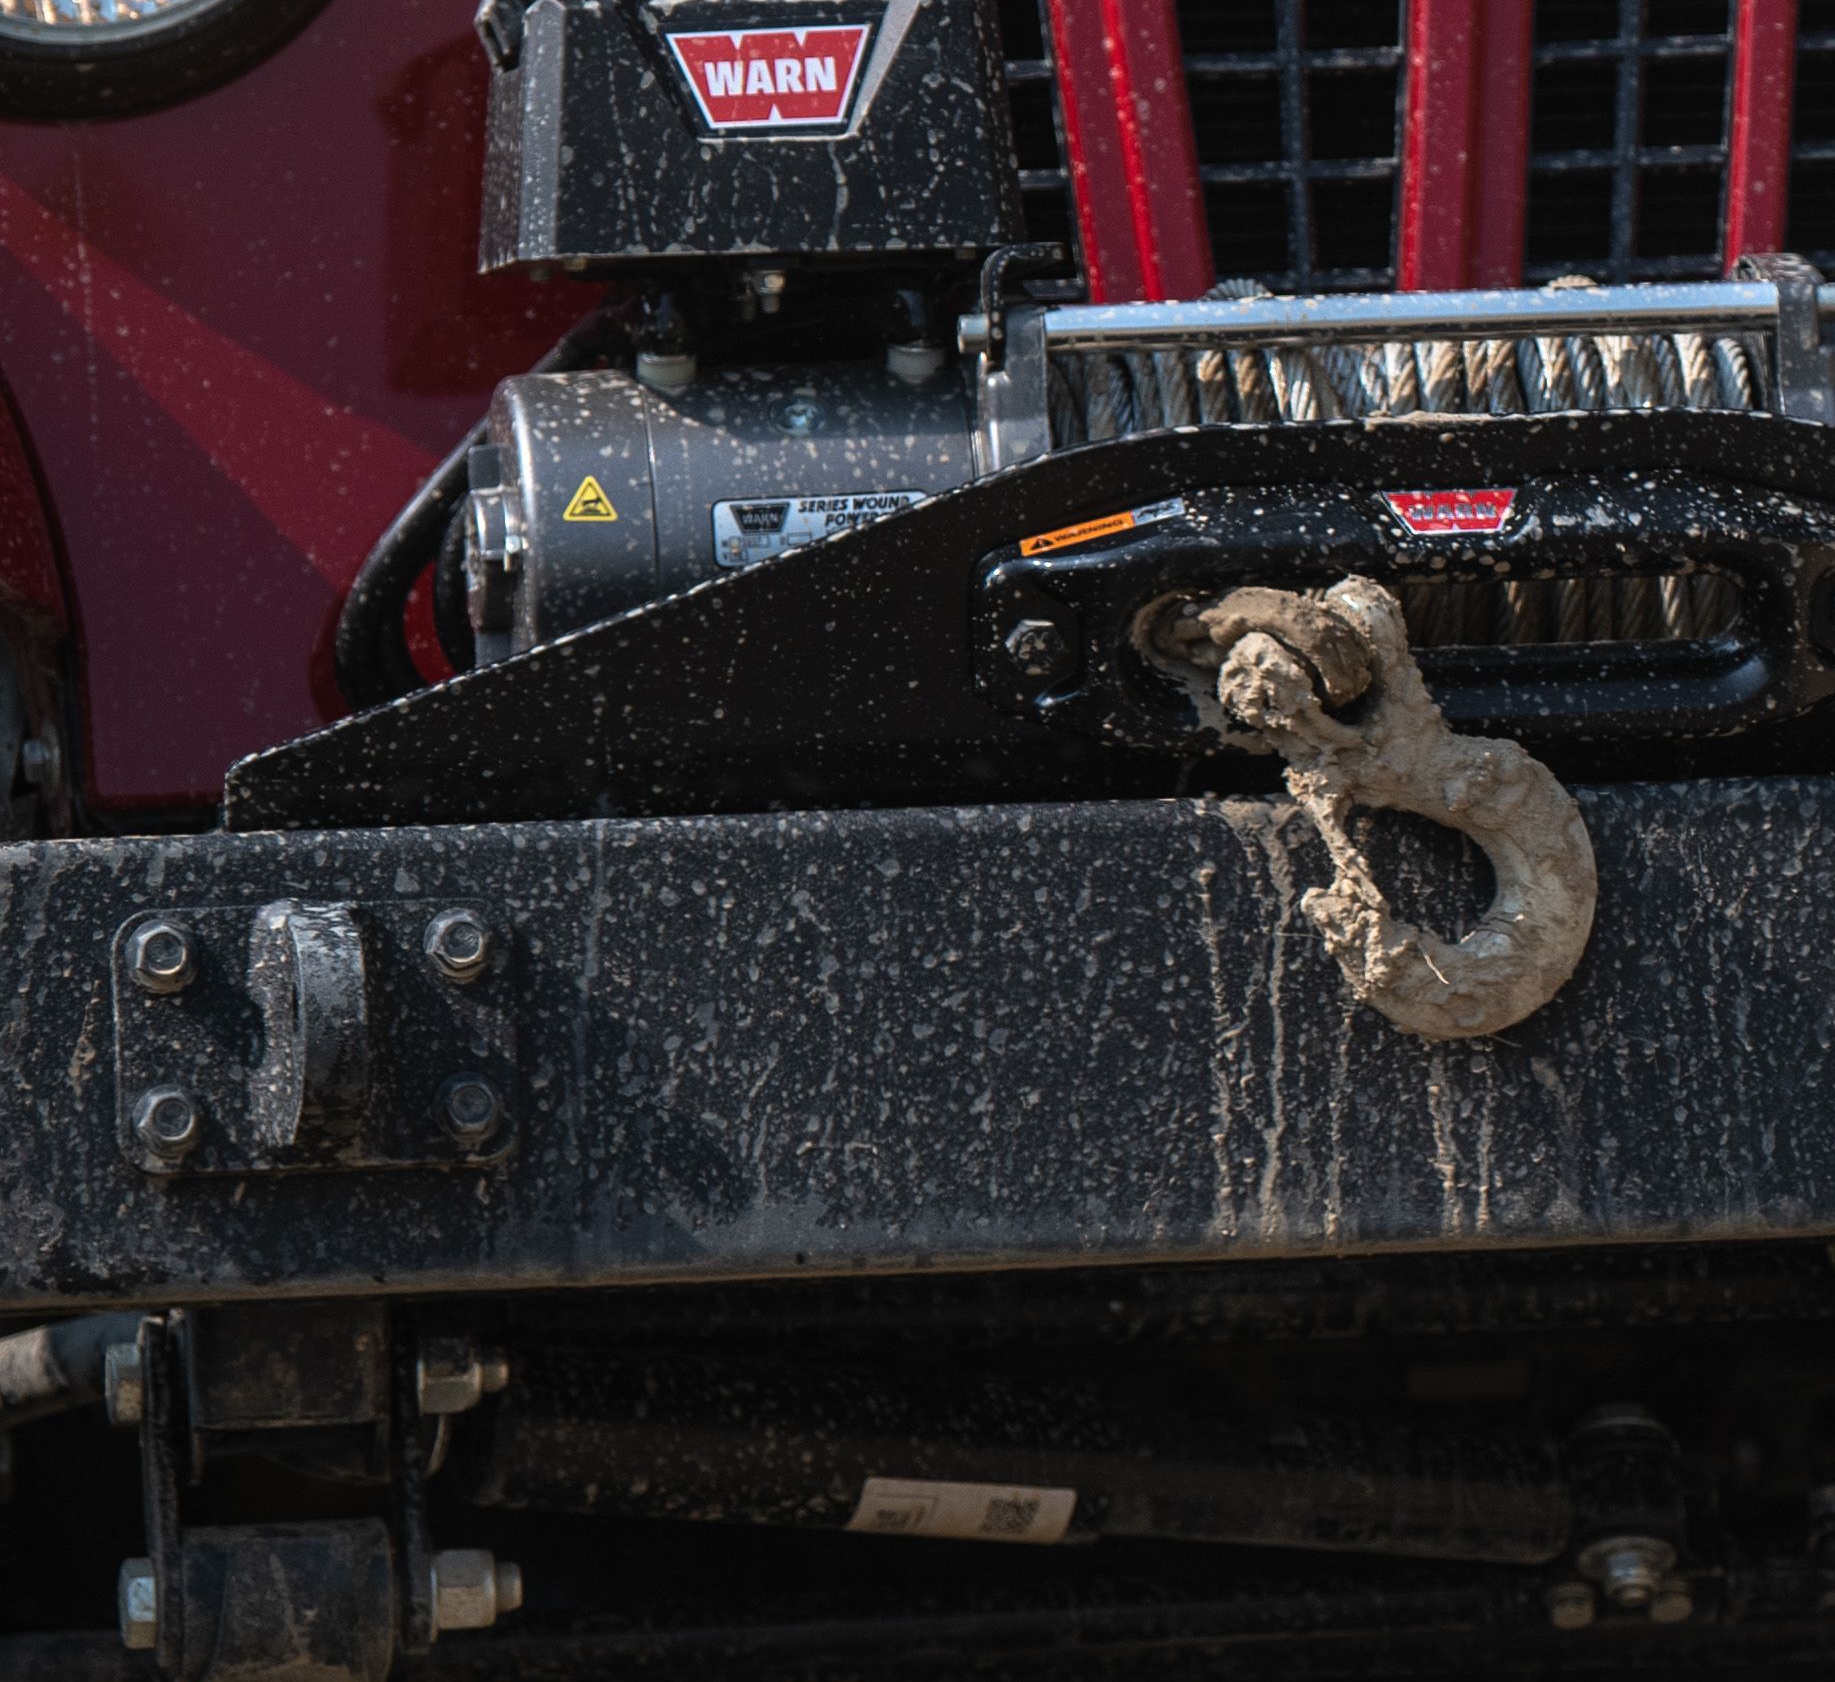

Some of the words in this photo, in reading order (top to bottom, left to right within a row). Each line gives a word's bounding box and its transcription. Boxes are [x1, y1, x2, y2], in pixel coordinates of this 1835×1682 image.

[704, 56, 837, 97] WARN
[798, 498, 849, 513] SERIES
[852, 495, 910, 510] WOUND
[1408, 502, 1496, 521] WARN
[1054, 518, 1124, 542] WARNING
